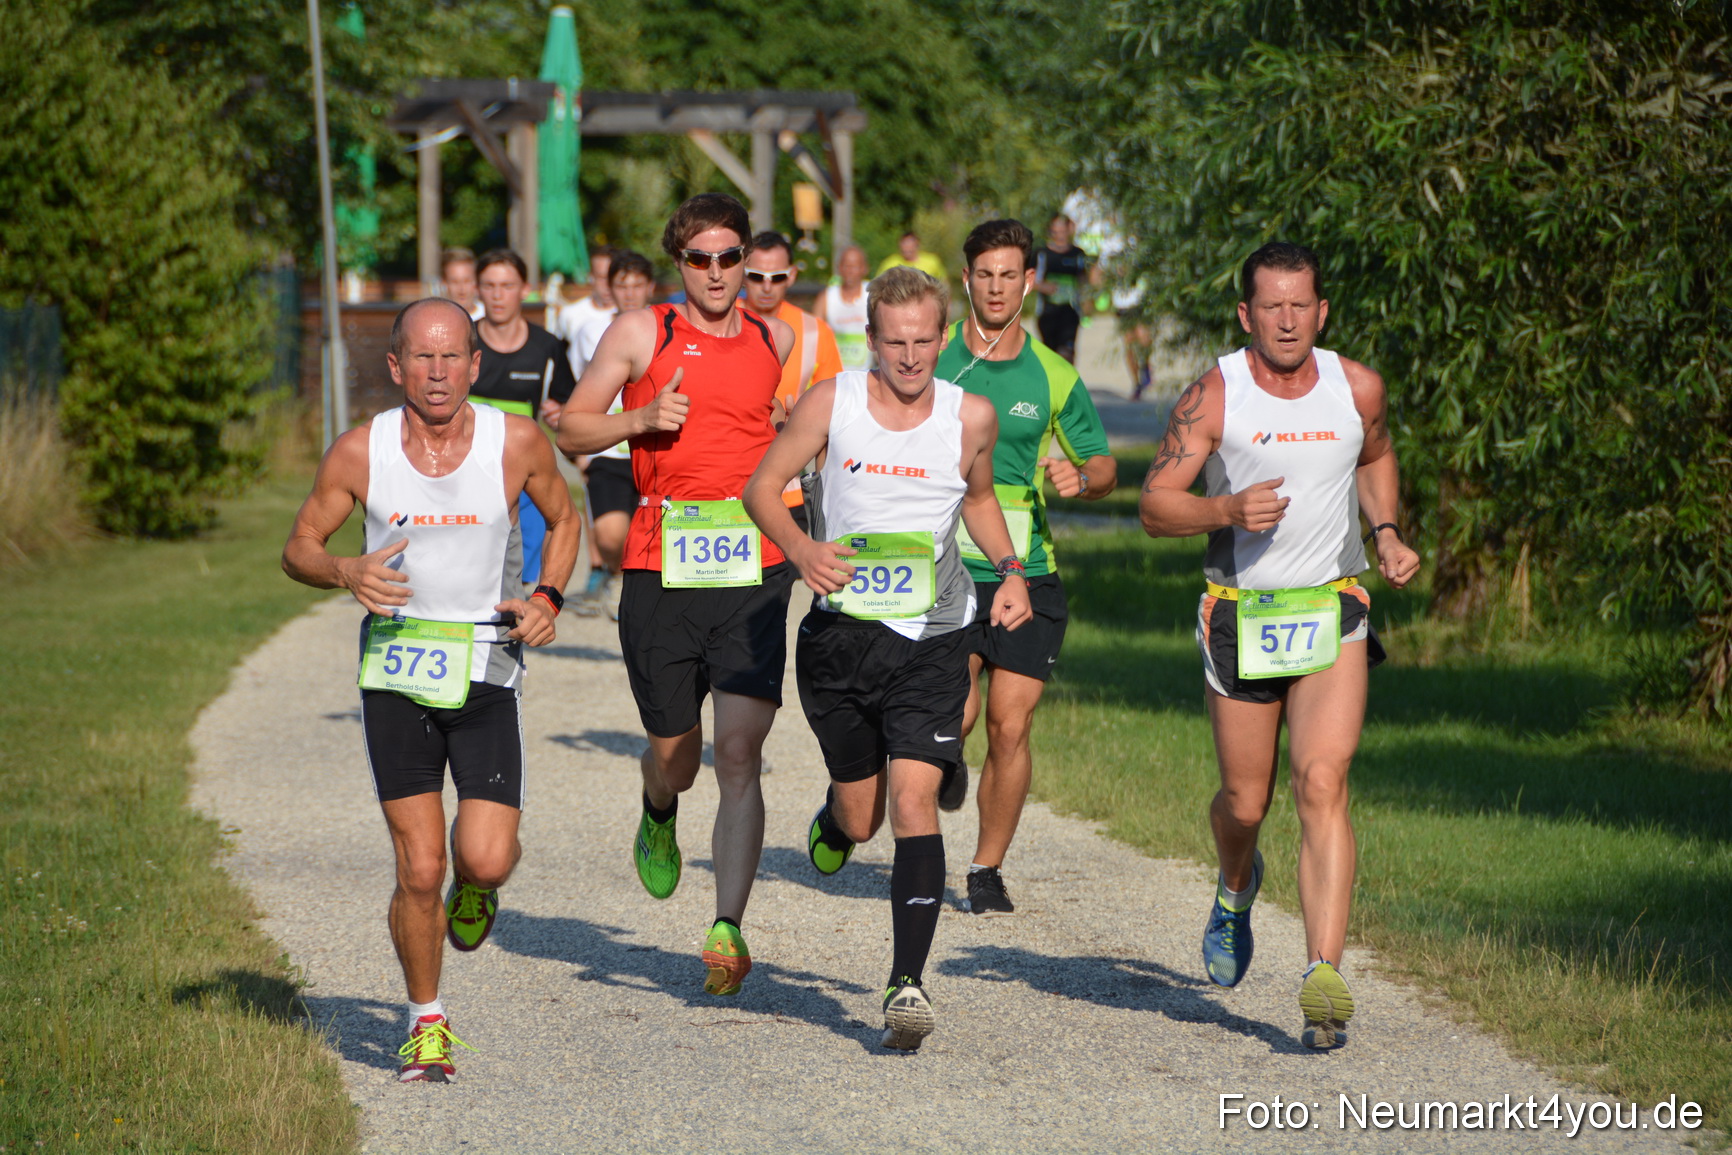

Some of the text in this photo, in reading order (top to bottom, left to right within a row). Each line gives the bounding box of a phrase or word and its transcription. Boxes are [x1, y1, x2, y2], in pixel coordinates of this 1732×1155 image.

[1010, 401, 1039, 416] AOK
[1276, 431, 1341, 443] KLEBL
[865, 463, 931, 479] KLEBL
[413, 514, 485, 526] KLEBL
[677, 514, 712, 522] firmenlauf
[673, 534, 752, 564] 1364
[850, 565, 913, 594] 592
[1252, 600, 1288, 609] firmenlauf
[1260, 621, 1320, 654] 577
[383, 644, 448, 680] 573
[1300, 656, 1313, 664] Graf
[385, 681, 440, 693] Berthold Schmid
